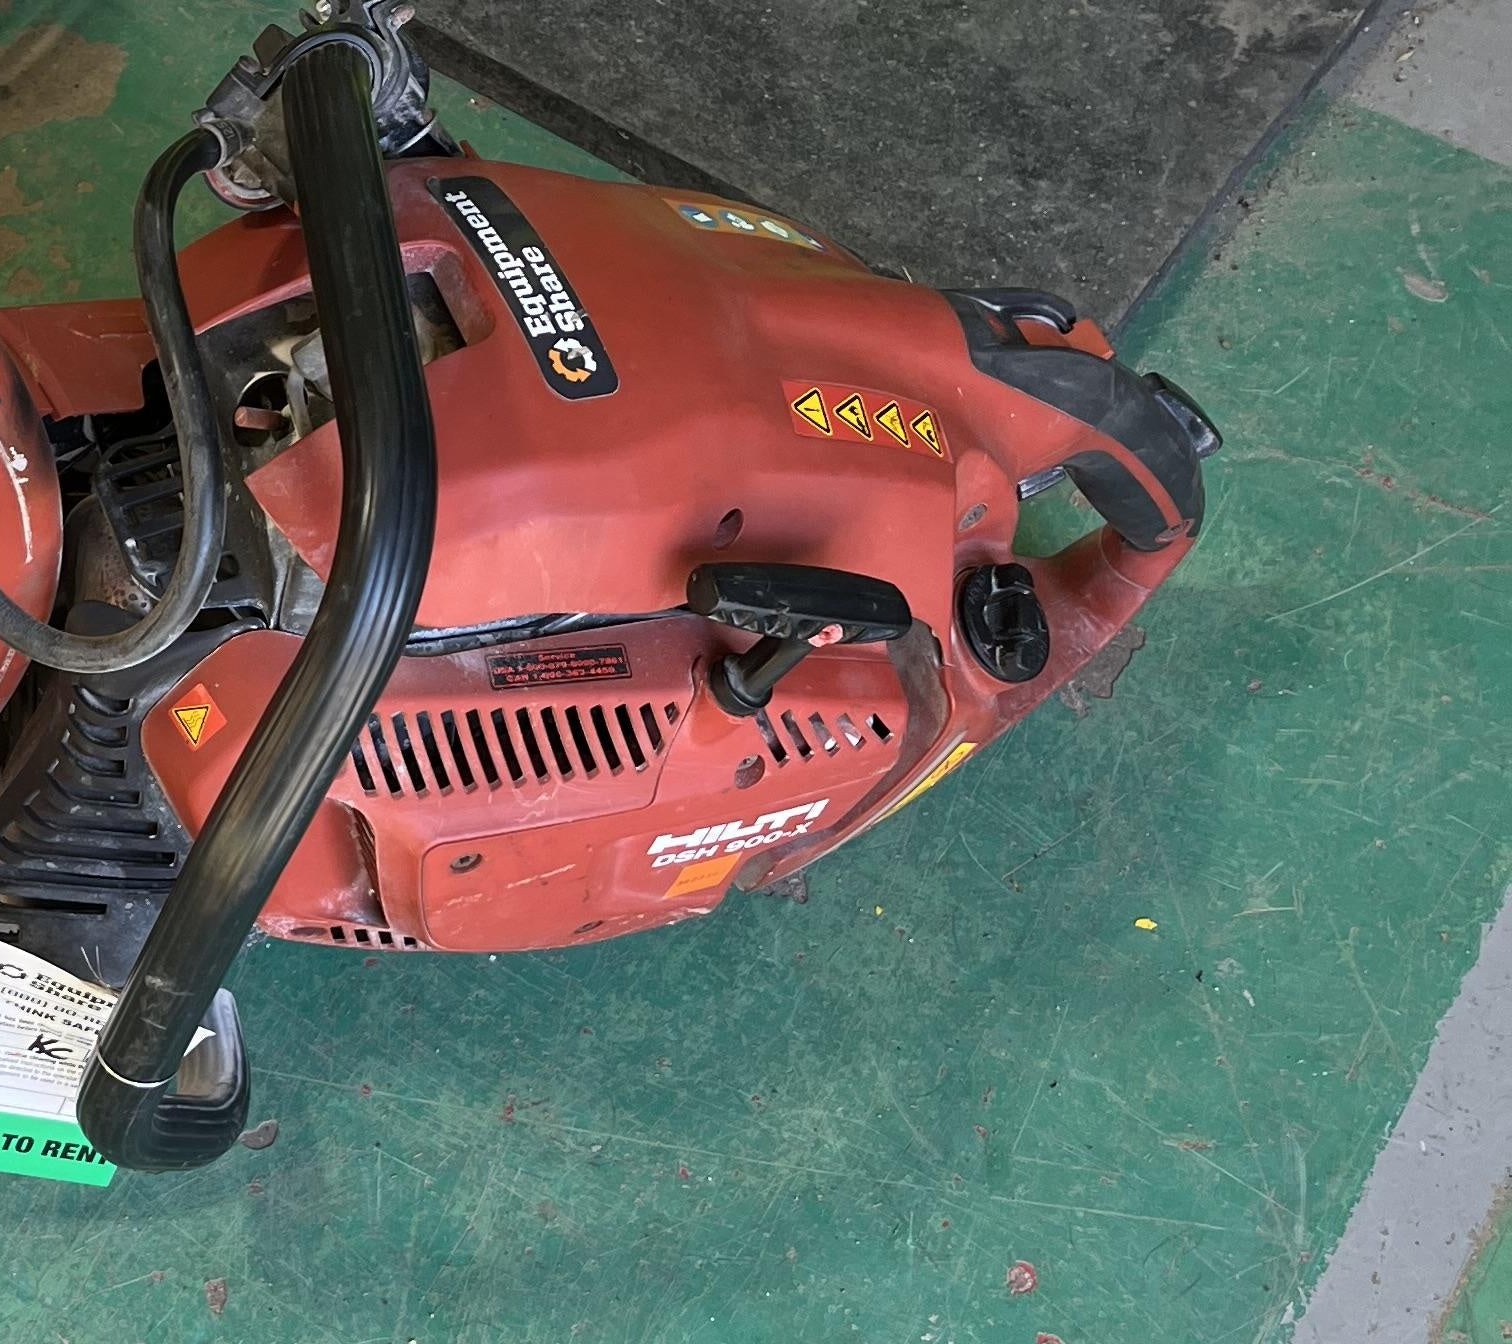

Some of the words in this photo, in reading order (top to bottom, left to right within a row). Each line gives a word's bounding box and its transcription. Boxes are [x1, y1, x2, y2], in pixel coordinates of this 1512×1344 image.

[445, 190, 556, 338] Equipment
[522, 246, 584, 333] Share
[538, 653, 576, 662] Service
[646, 798, 830, 855] HILTI
[651, 844, 720, 868] DSH
[724, 821, 814, 853] 900-X
[30, 980, 102, 1011] Share
[1, 1133, 35, 1154] TO
